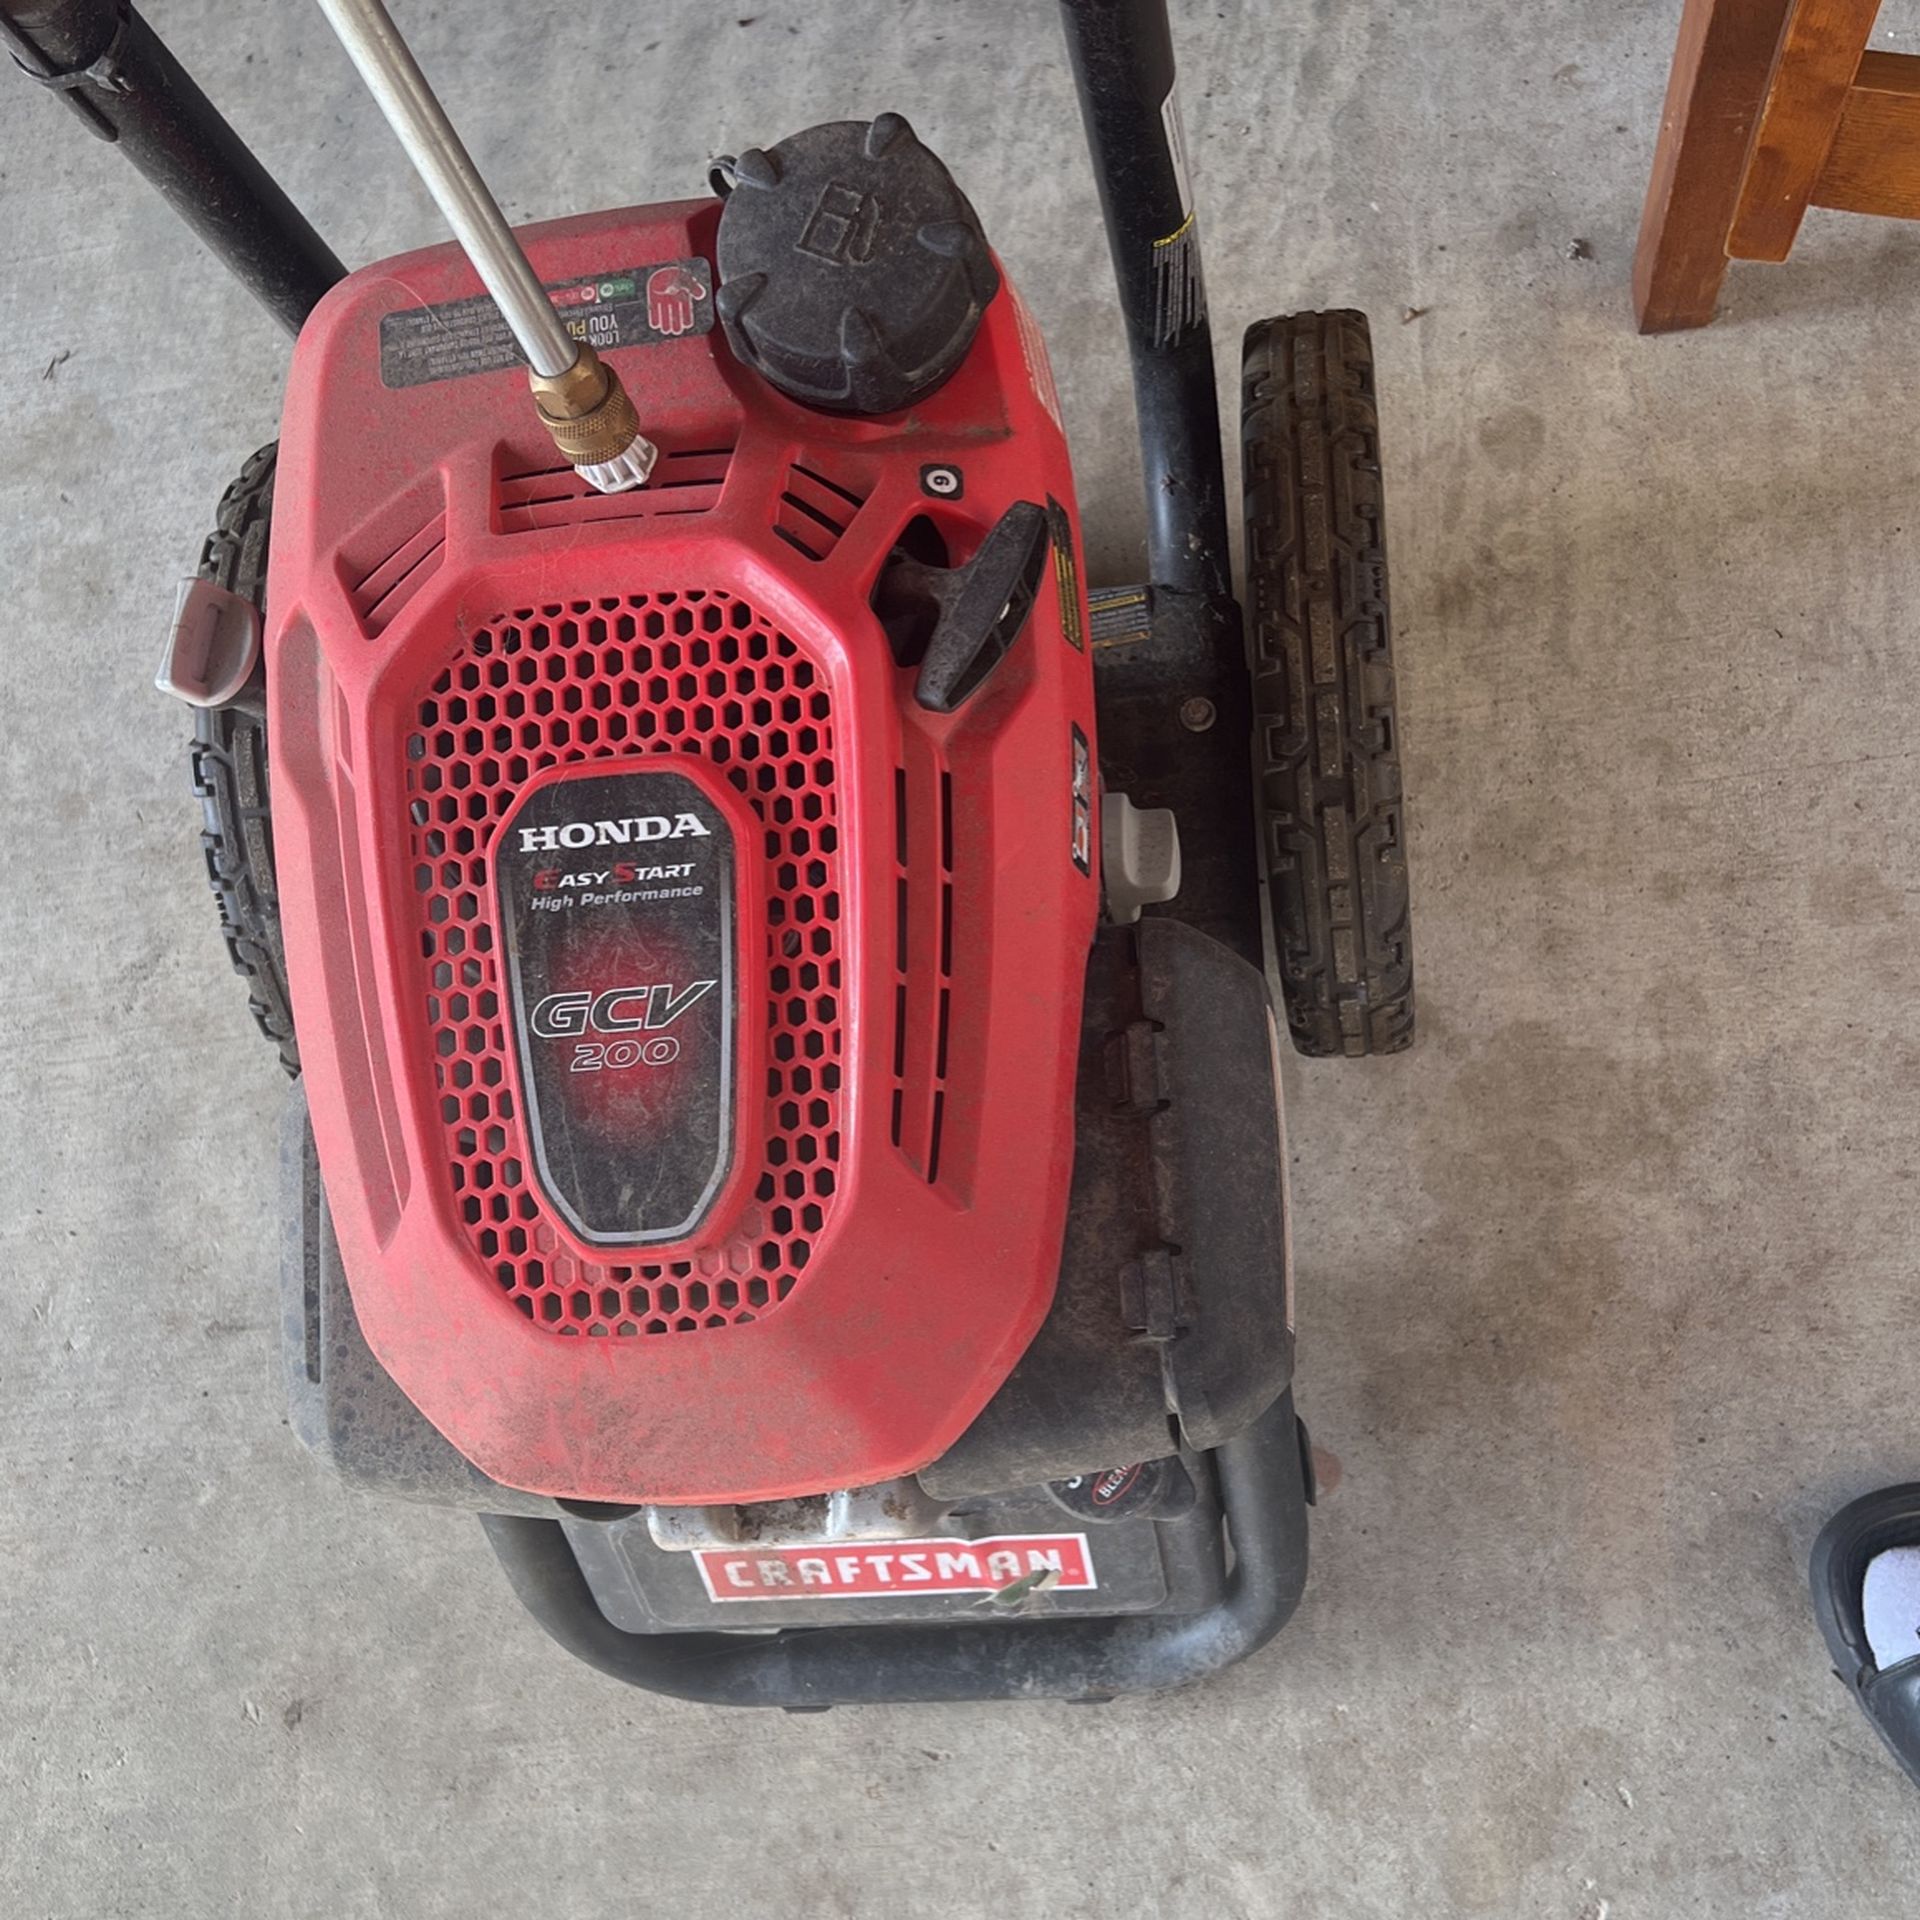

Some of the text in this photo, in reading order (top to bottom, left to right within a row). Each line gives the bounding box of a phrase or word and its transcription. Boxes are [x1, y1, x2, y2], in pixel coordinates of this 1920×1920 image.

[566, 314, 619, 337] YOU PU
[588, 331, 620, 348] LOOK
[518, 813, 711, 852] HONDA
[533, 861, 696, 891] EASY START
[531, 886, 704, 912] High Performance
[531, 980, 718, 1038] GCV
[570, 1036, 680, 1072] 200
[1098, 1465, 1129, 1498] BLEA
[723, 1549, 1062, 1588] CRAFTSMAN
